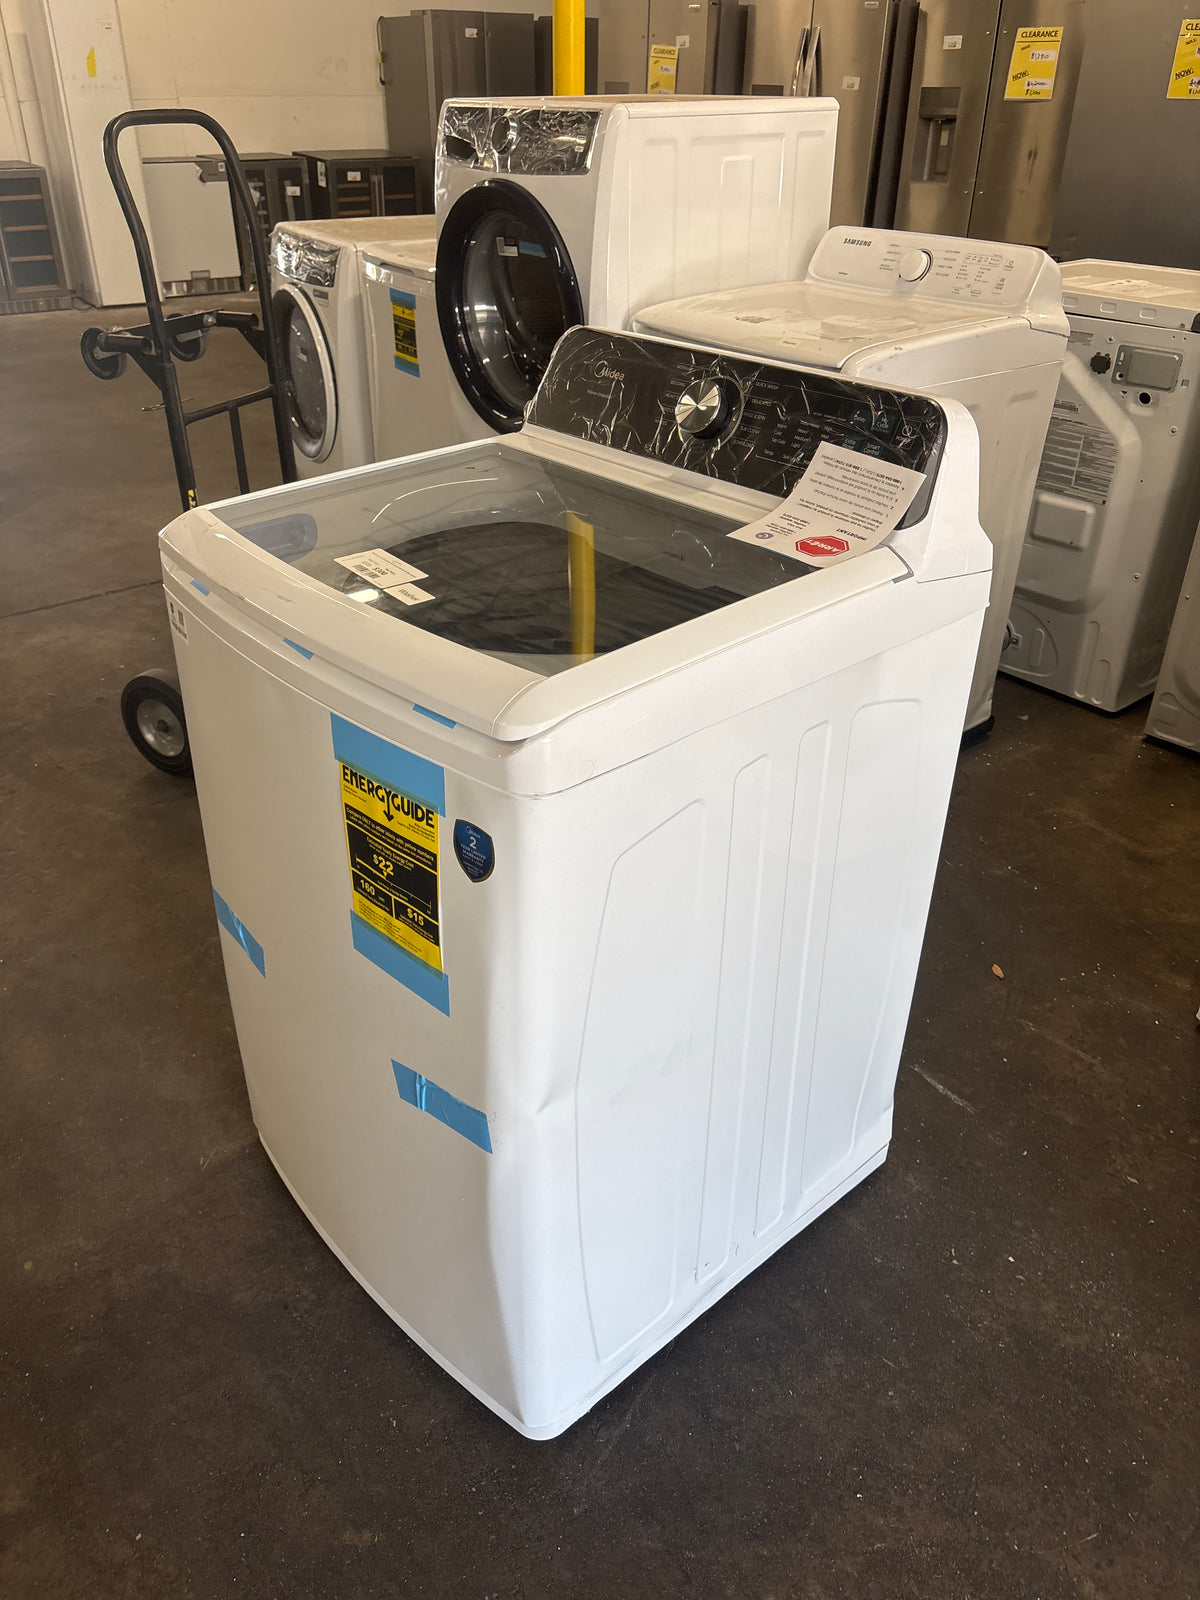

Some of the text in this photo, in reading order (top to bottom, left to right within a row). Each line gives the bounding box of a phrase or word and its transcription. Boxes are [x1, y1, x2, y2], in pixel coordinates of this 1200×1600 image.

[1021, 30, 1059, 38] CLEARANCE
[654, 48, 676, 56] CLEARANCE
[1175, 67, 1194, 80] NOW:
[843, 238, 872, 247] SAMSUNG
[594, 360, 624, 381] Midea
[852, 413, 866, 423] Delay
[836, 528, 867, 541] IMPORTANT
[804, 538, 840, 553] ARRÊT
[342, 764, 435, 829] ENERGYGUIDE
[361, 815, 371, 825] ONLY
[469, 836, 477, 850] 2
[372, 853, 394, 874] $22
[360, 879, 375, 895] 160
[407, 907, 424, 926] $15
